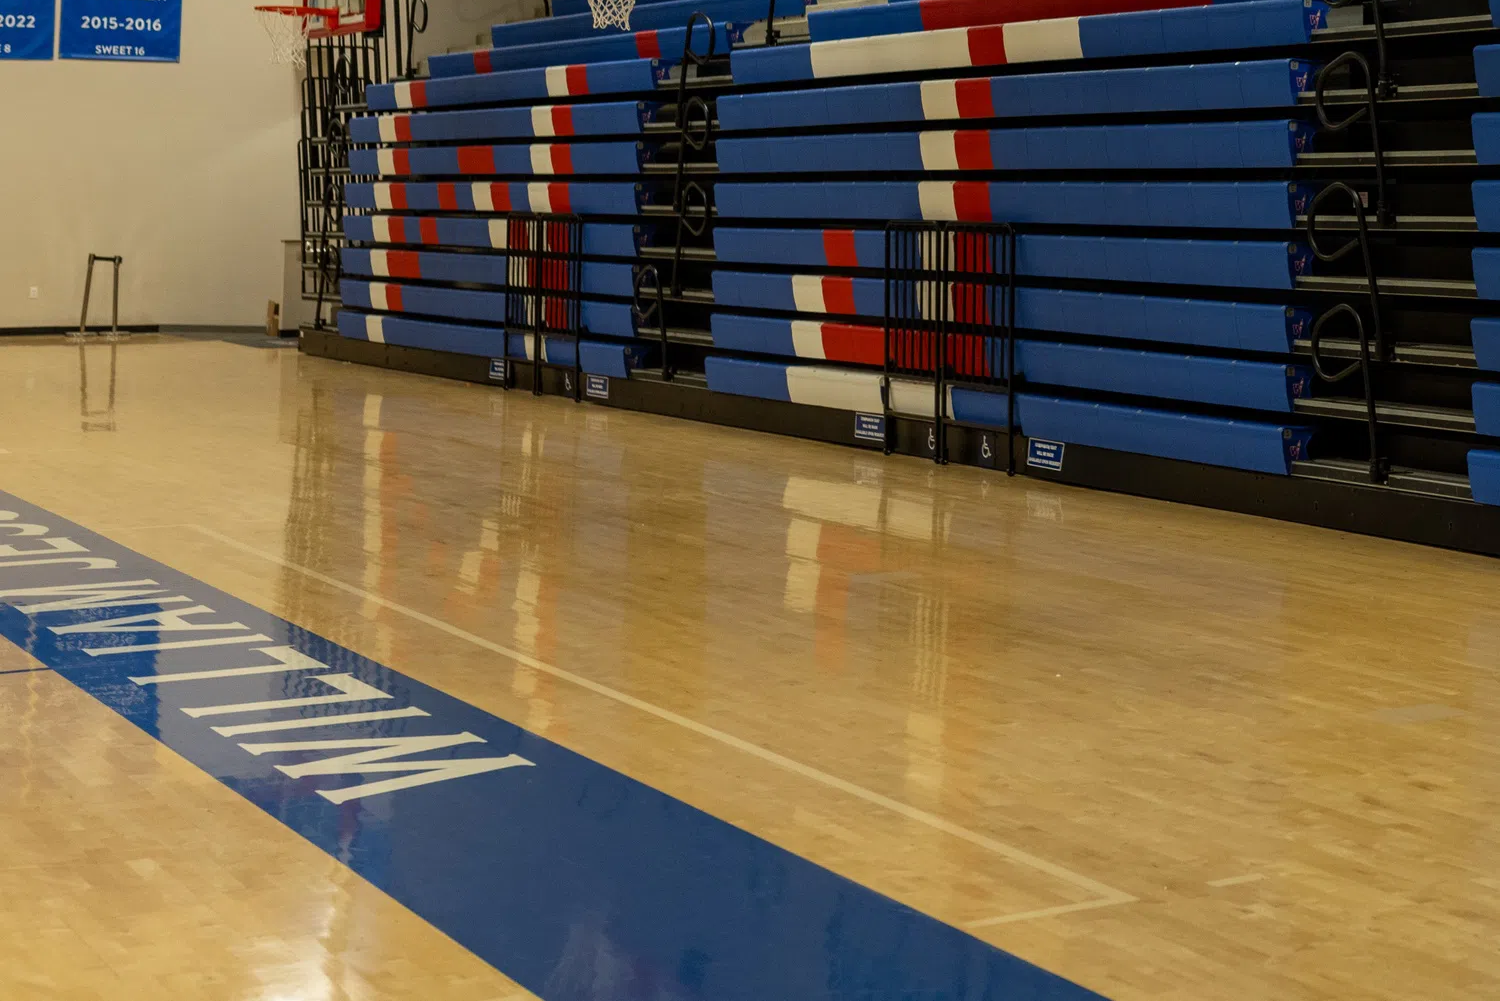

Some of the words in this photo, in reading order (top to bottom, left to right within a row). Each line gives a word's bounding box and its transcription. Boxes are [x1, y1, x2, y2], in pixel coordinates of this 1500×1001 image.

[80, 15, 162, 31] 2015-2016
[95, 45, 132, 55] SWEET
[134, 46, 145, 56] 16
